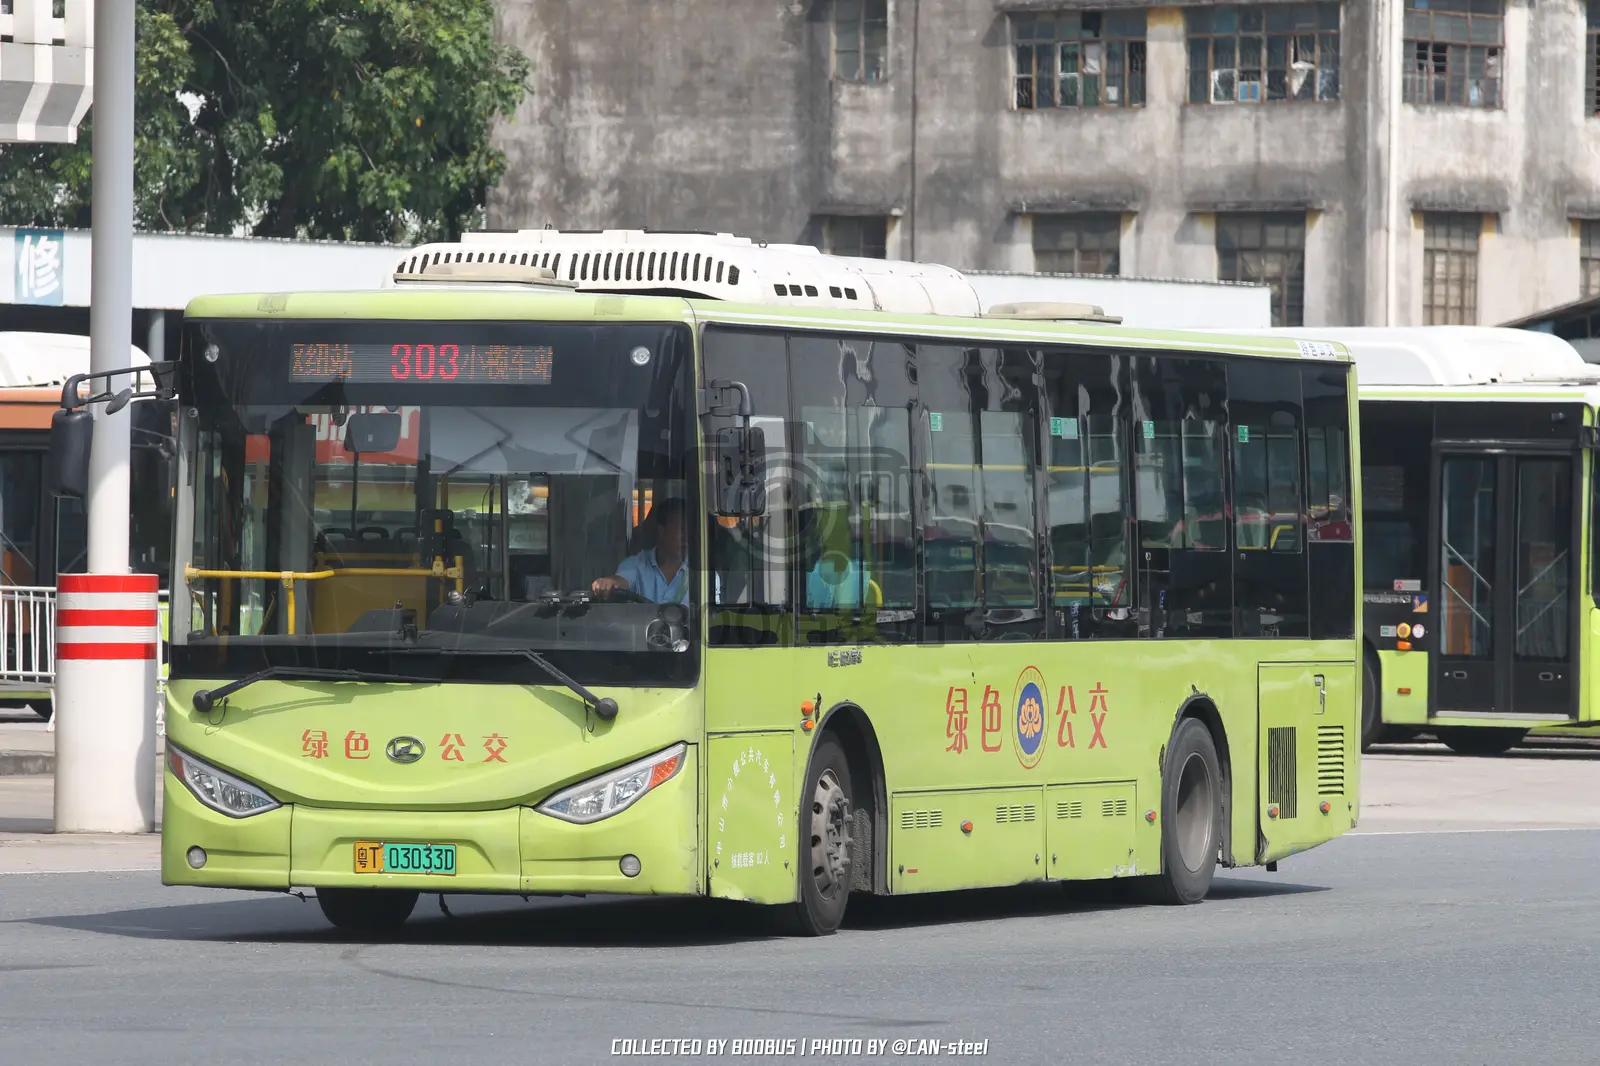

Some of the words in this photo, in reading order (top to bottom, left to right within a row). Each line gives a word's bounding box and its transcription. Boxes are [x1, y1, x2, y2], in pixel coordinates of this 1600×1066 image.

[18, 234, 61, 298] 修
[391, 343, 460, 380] 303
[945, 684, 1003, 755] 绿色
[1055, 681, 1109, 750] 公交
[301, 729, 371, 760] 绿色
[438, 733, 510, 763] 公交
[389, 847, 455, 871] 03033D
